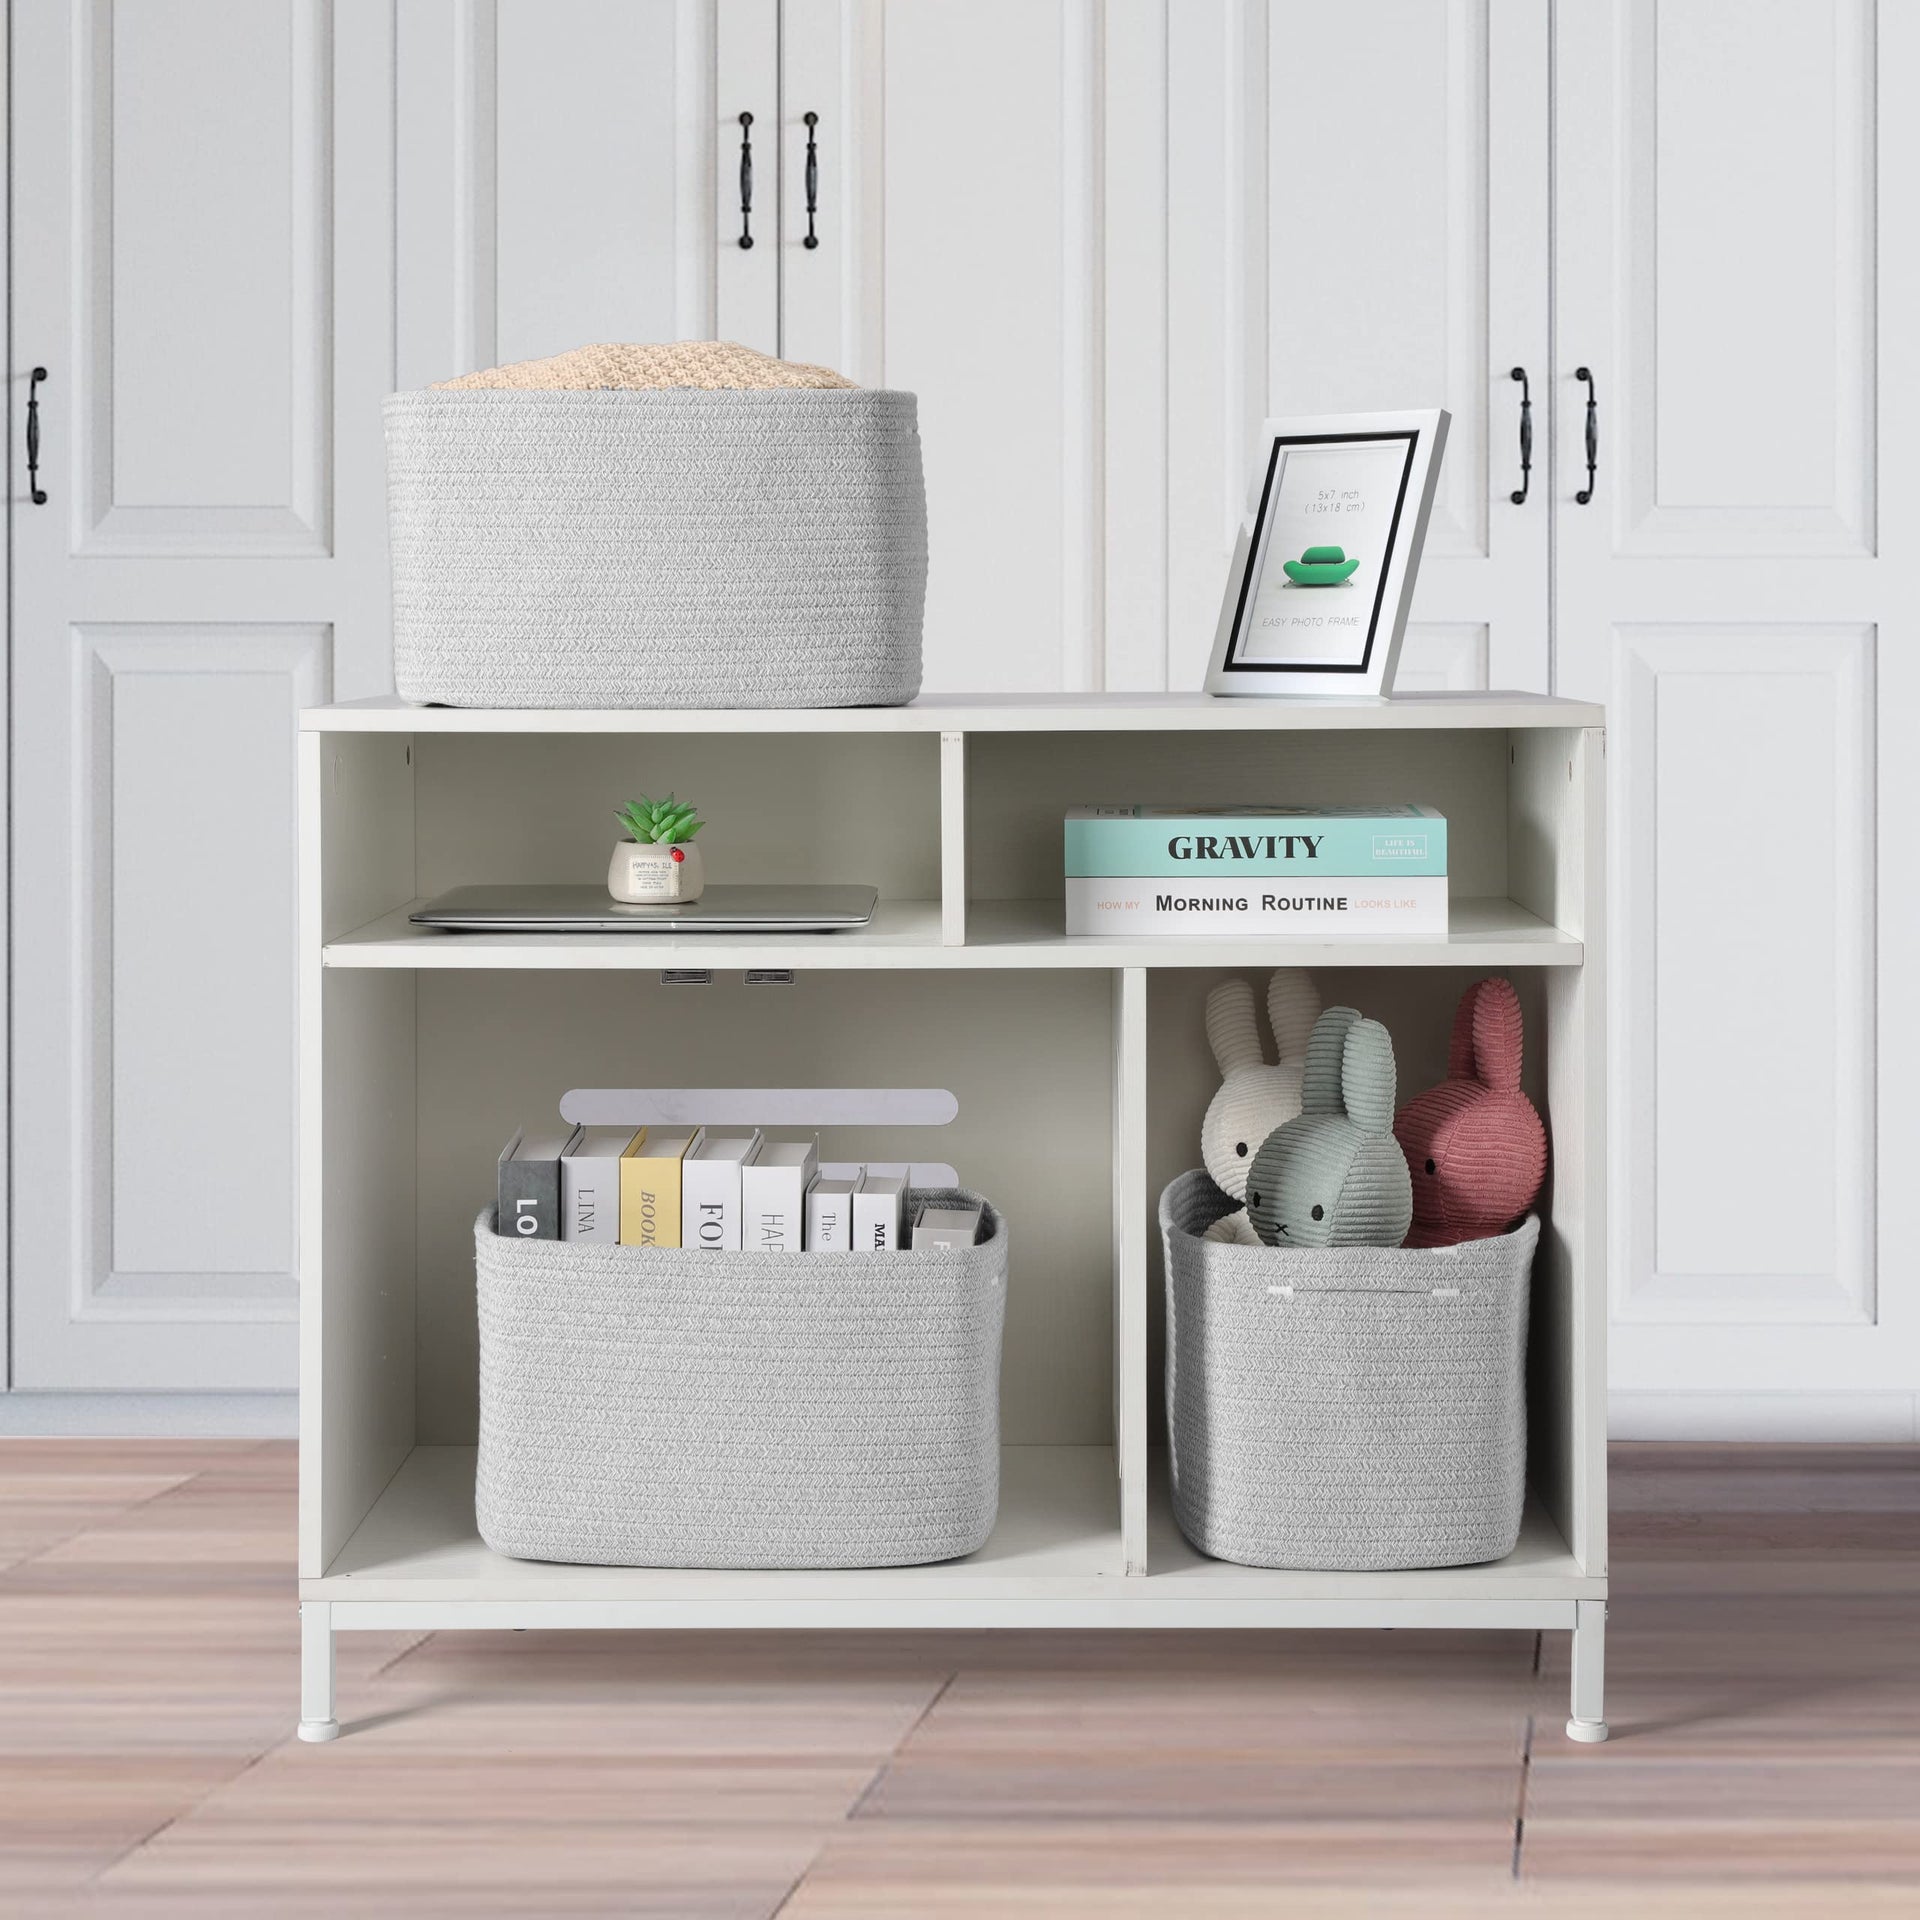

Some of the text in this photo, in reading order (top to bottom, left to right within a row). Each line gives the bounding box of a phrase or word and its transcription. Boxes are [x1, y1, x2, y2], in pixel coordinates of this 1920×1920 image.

[1317, 489, 1360, 501] 5x7 inch
[1262, 616, 1360, 627] EASY PHOTO FRAME
[1168, 835, 1325, 860] GRAVITY
[1406, 839, 1416, 847] IS
[1097, 895, 1417, 911] HOW MY MORNING ROUTINE LOOKS LIKE
[516, 1199, 538, 1235] LO
[578, 1188, 595, 1234] LINA
[640, 1189, 656, 1248] BOOK
[821, 1212, 836, 1241] The
[874, 1223, 885, 1251] MA
